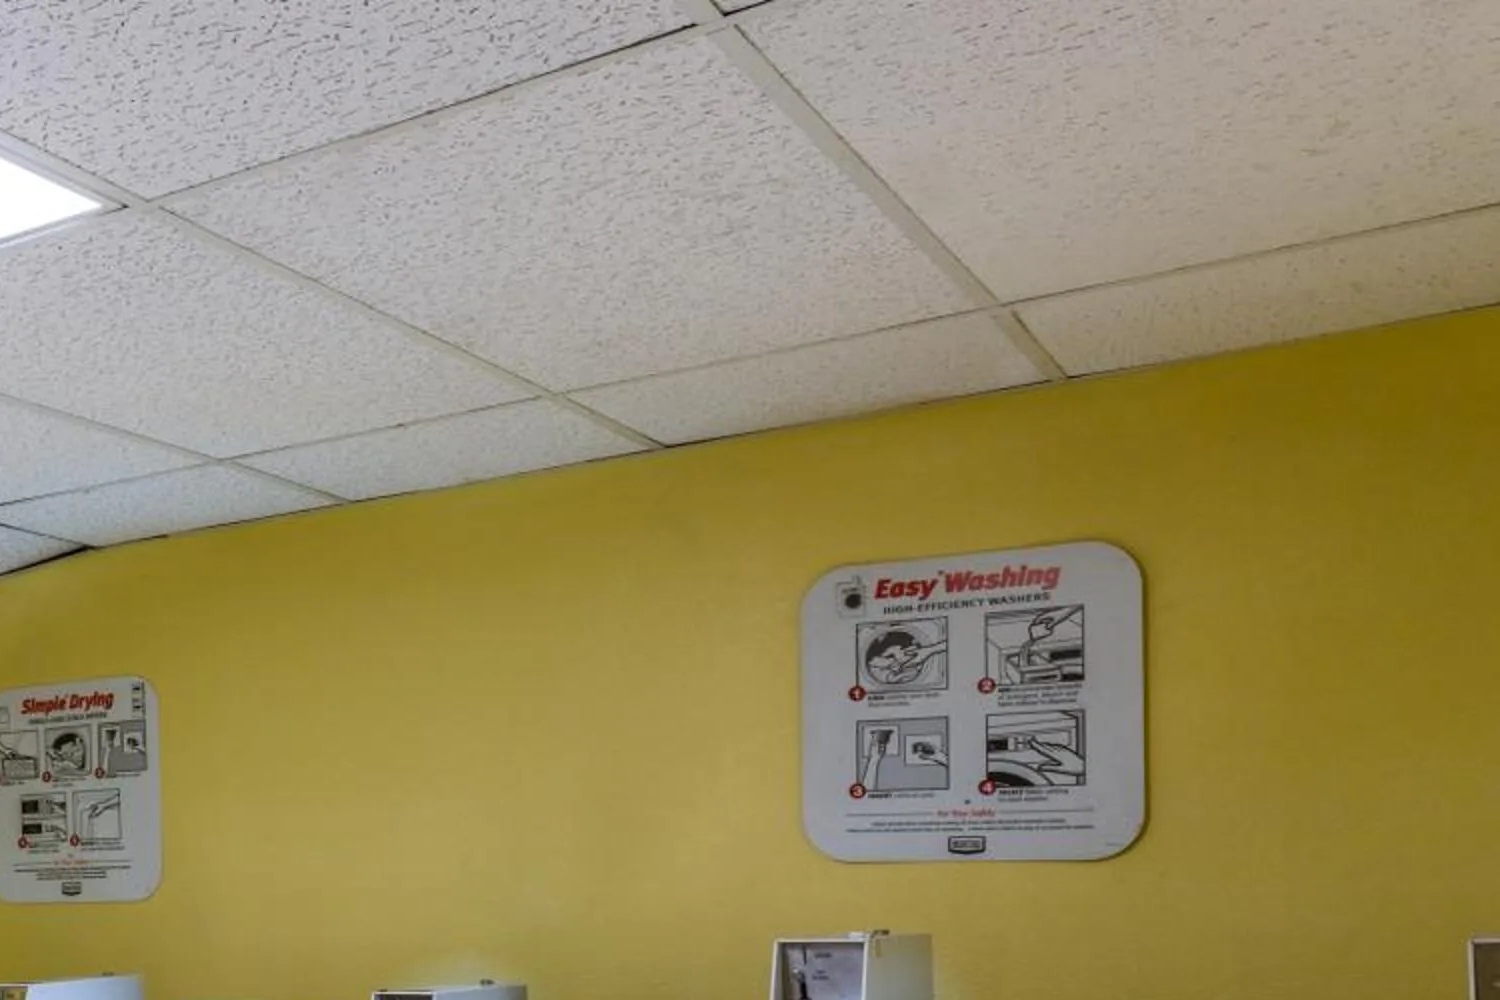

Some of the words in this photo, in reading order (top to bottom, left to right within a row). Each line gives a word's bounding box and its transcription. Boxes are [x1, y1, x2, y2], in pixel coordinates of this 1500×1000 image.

[874, 576, 938, 601] Easy
[945, 565, 1062, 593] Washing
[883, 599, 984, 615] HIGH-EFFICIENCY
[987, 592, 1052, 605] WASHERS
[21, 695, 67, 716] Simple
[68, 690, 115, 713] Drying
